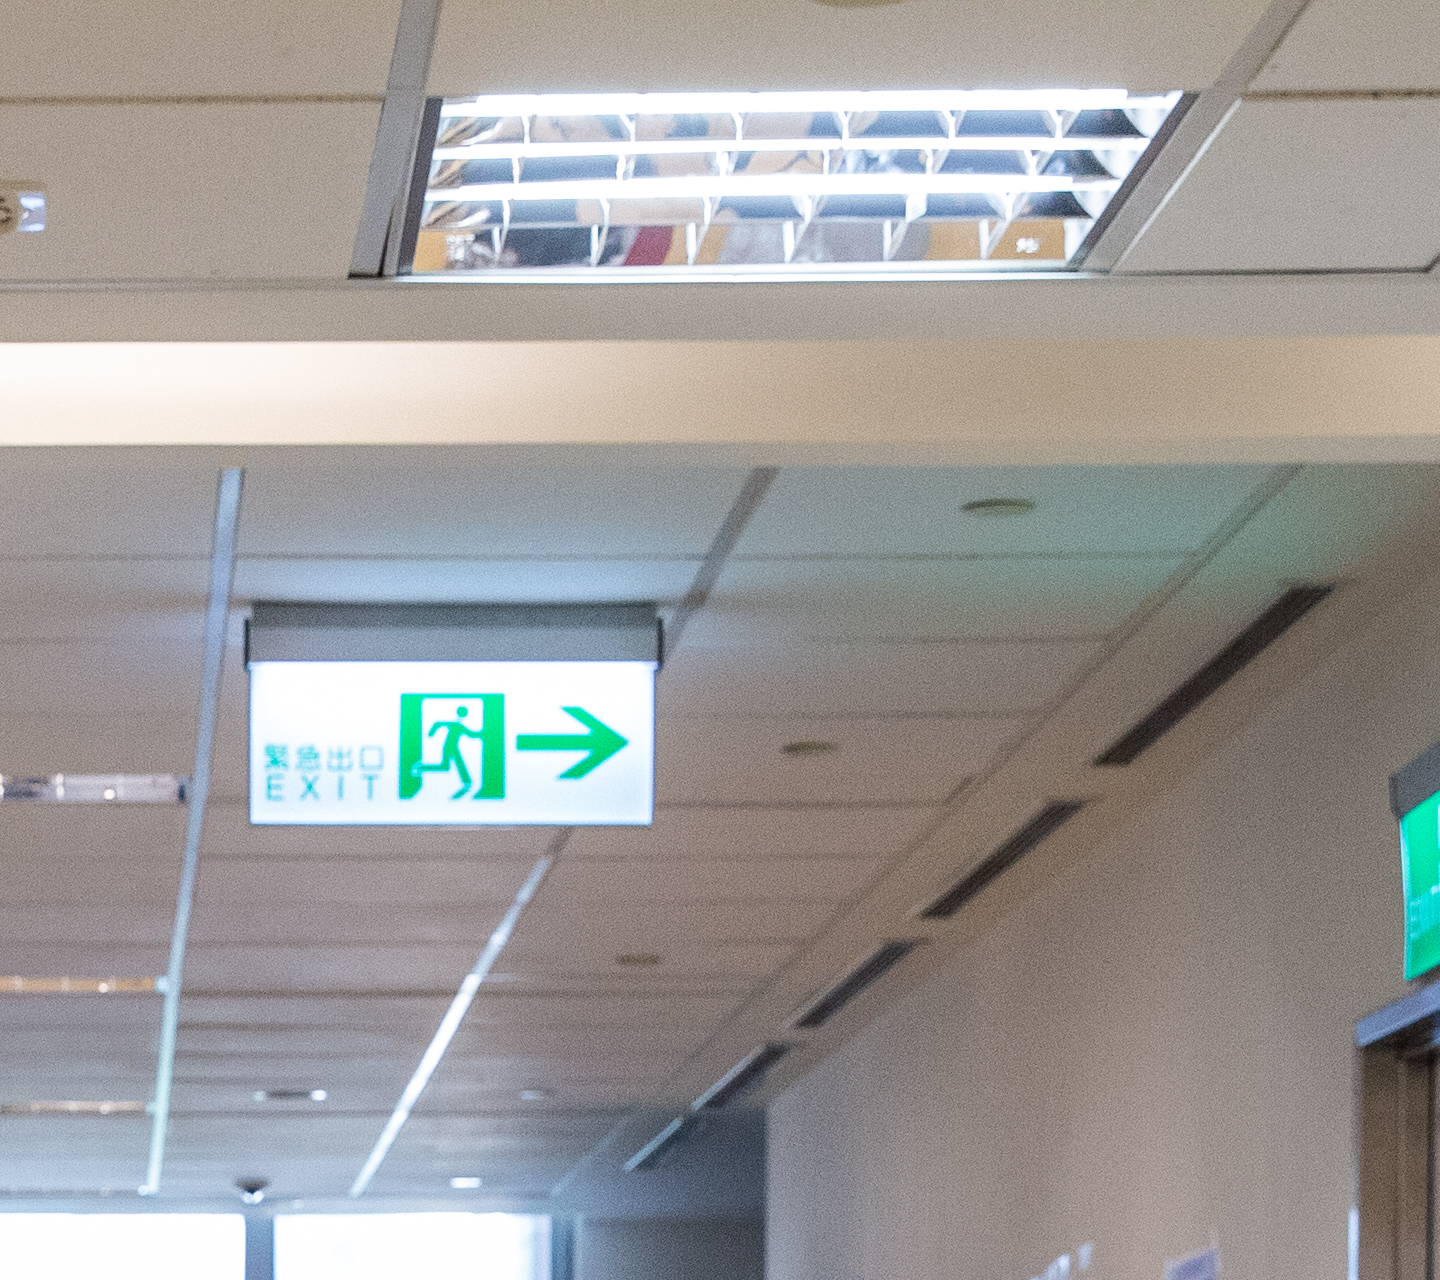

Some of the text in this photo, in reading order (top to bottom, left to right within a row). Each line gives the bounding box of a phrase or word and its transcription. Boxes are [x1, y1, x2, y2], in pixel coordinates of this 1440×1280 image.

[264, 744, 384, 772] 緊急出口
[265, 774, 379, 802] EXIT
